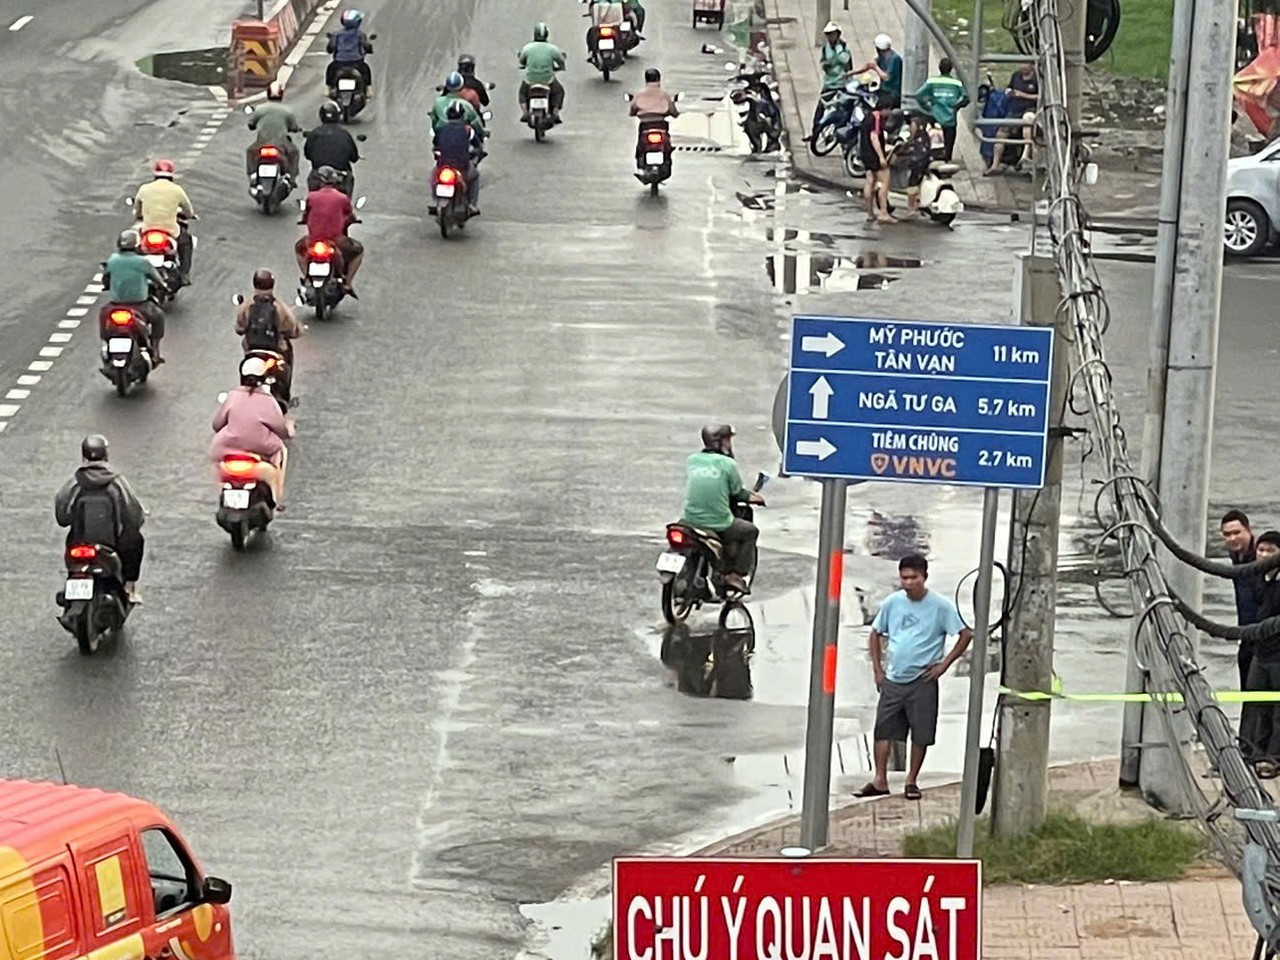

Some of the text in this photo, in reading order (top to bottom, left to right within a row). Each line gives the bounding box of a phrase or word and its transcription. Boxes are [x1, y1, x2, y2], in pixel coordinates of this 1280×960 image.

[869, 325, 965, 348] MỸ PHƯỚC
[875, 351, 955, 375] TÂN VẠN
[993, 346, 1039, 363] 11 km
[858, 390, 956, 413] NGÃ TƯ GA
[978, 398, 1036, 417] 5.7 km
[872, 431, 906, 450] TIÊM
[893, 454, 956, 477] VNVC
[978, 451, 1032, 468] 2.7 km
